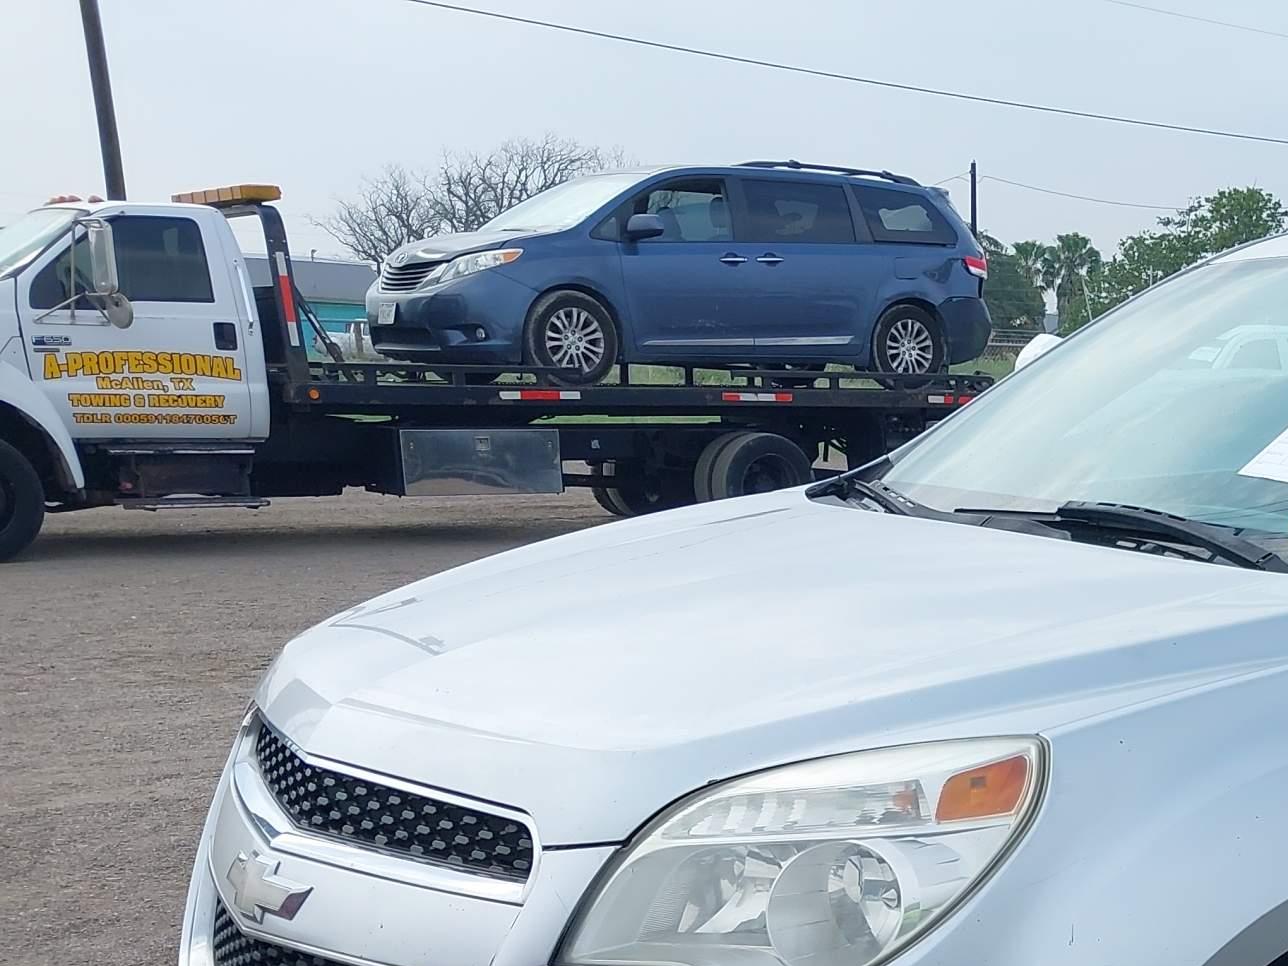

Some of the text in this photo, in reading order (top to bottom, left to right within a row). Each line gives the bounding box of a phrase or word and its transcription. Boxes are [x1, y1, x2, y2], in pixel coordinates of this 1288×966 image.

[44, 351, 241, 381] A-PROFESSIONAL
[96, 377, 195, 392] McAllen, TX
[68, 393, 225, 409] TOWING & RECOVERY
[73, 413, 112, 424] TDLR
